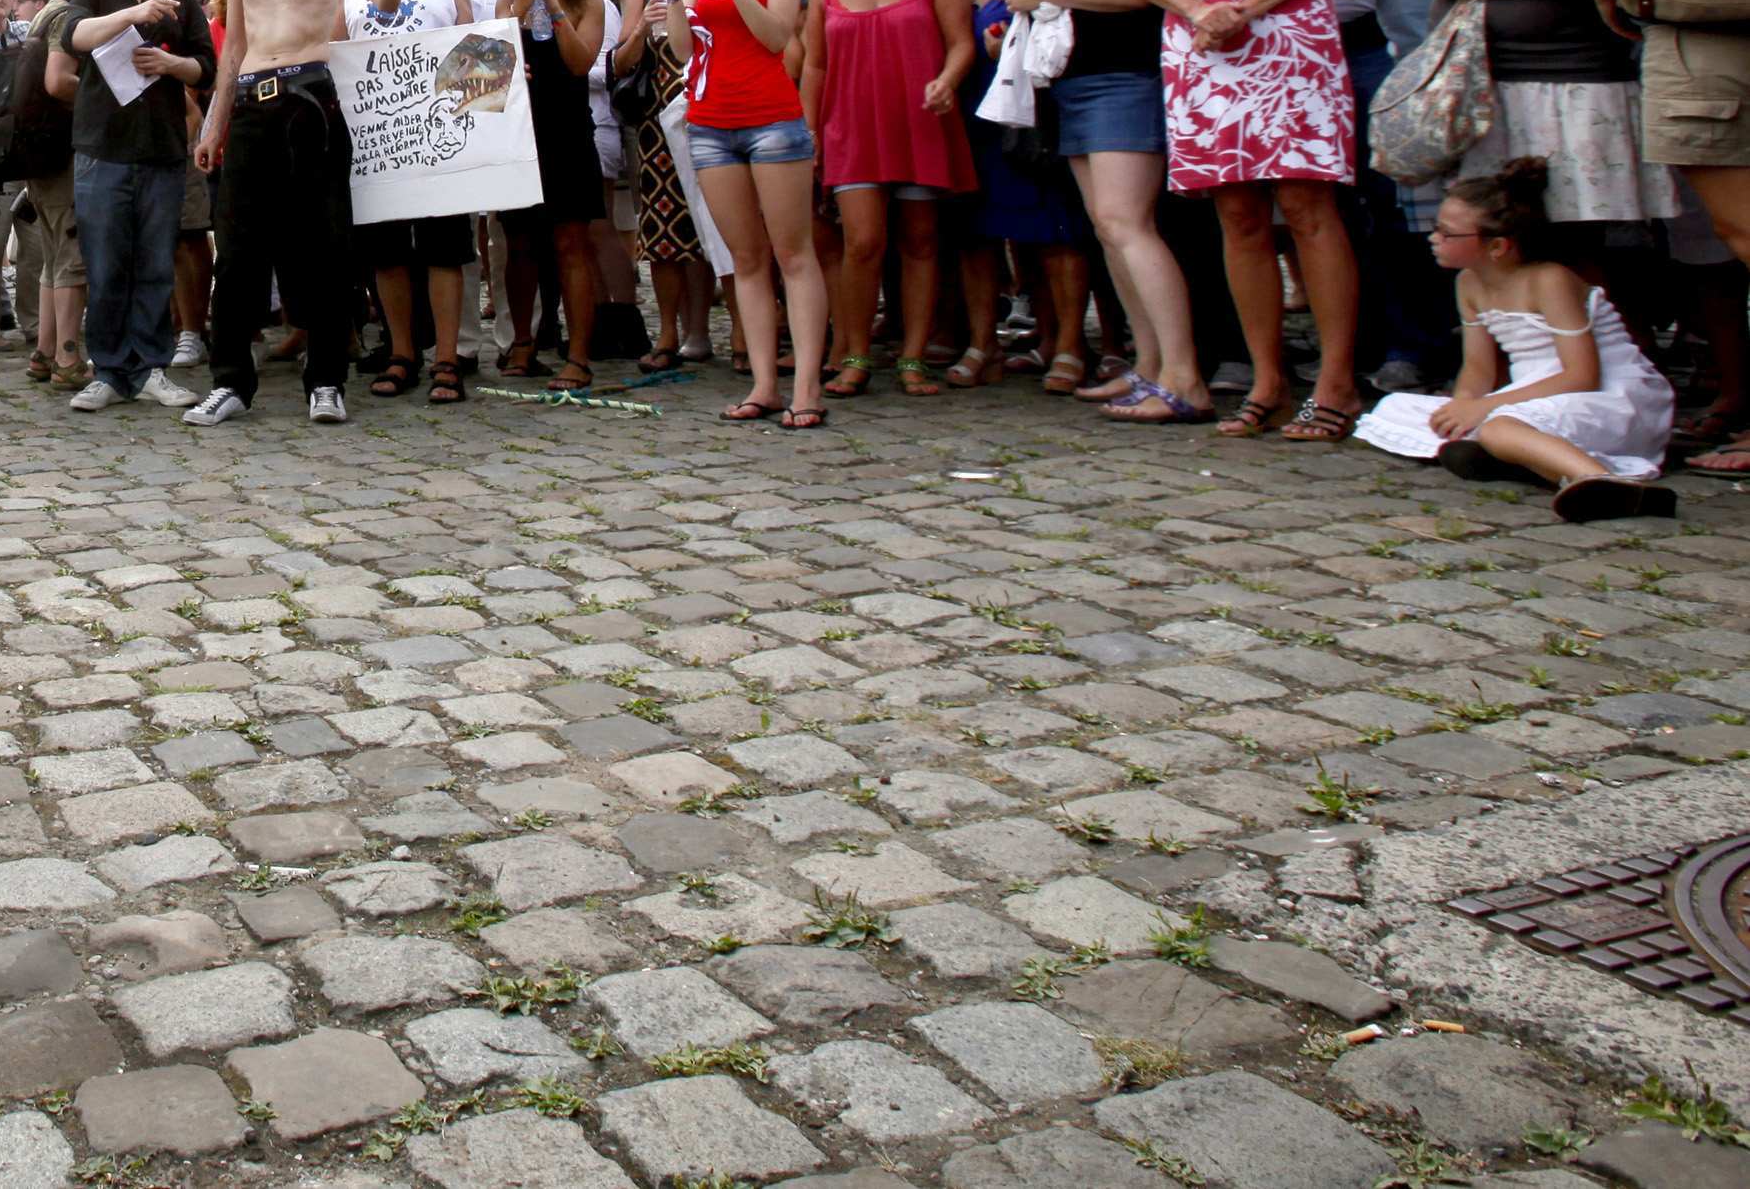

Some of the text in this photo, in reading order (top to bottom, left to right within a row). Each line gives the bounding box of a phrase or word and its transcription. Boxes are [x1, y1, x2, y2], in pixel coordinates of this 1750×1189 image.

[366, 43, 421, 74] LAISSE
[277, 65, 302, 75] LEO
[355, 51, 439, 100] PAS SORTIR
[353, 101, 373, 114] UN
[393, 114, 421, 128] AIDER
[357, 138, 377, 150] LES
[373, 161, 386, 172] LA
